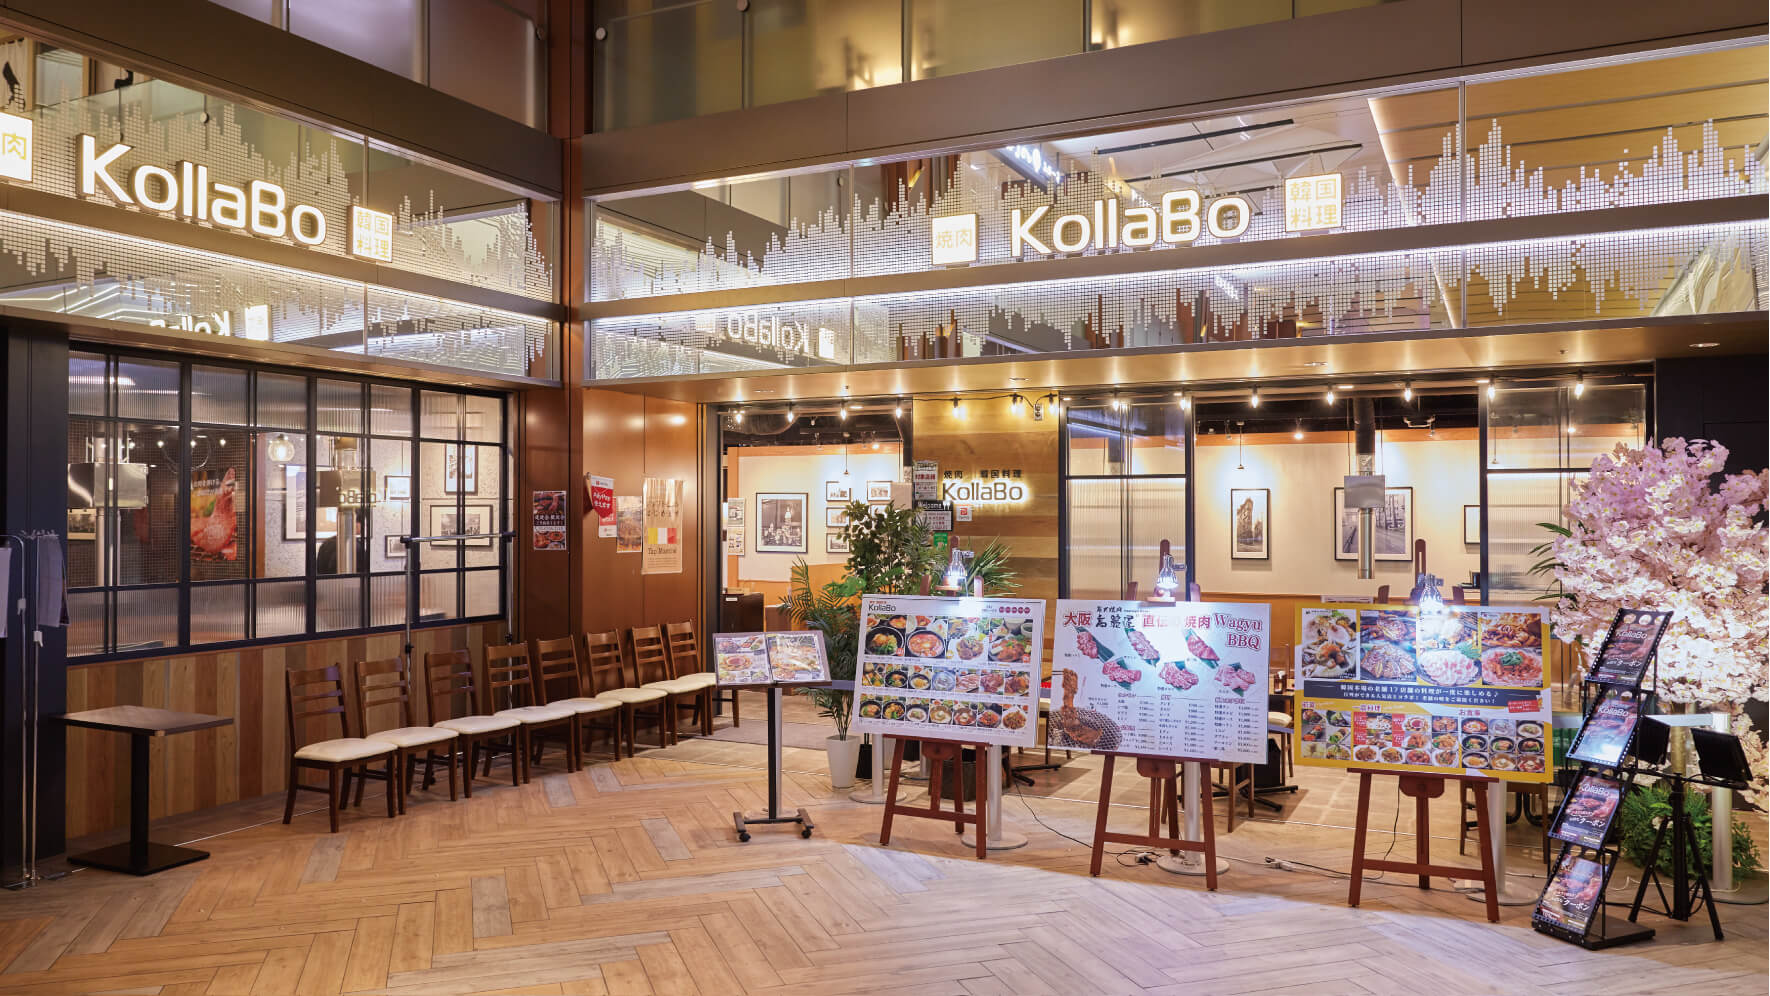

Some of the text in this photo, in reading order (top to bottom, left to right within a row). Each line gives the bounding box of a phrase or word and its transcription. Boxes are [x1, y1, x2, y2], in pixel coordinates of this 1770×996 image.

[80, 134, 327, 246] KollaBo
[1289, 179, 1337, 202] 韓国
[356, 211, 390, 236] 韓国
[1011, 188, 1251, 258] KollaBo
[1289, 205, 1337, 229] 料理
[356, 236, 390, 258] 料理
[935, 228, 973, 250] 焼肉
[944, 470, 963, 480] 焼肉
[942, 482, 1023, 501] KollaBo
[1064, 611, 1092, 627] 大阪
[1214, 613, 1263, 632] Wagyu
[1226, 633, 1261, 650] BBQ
